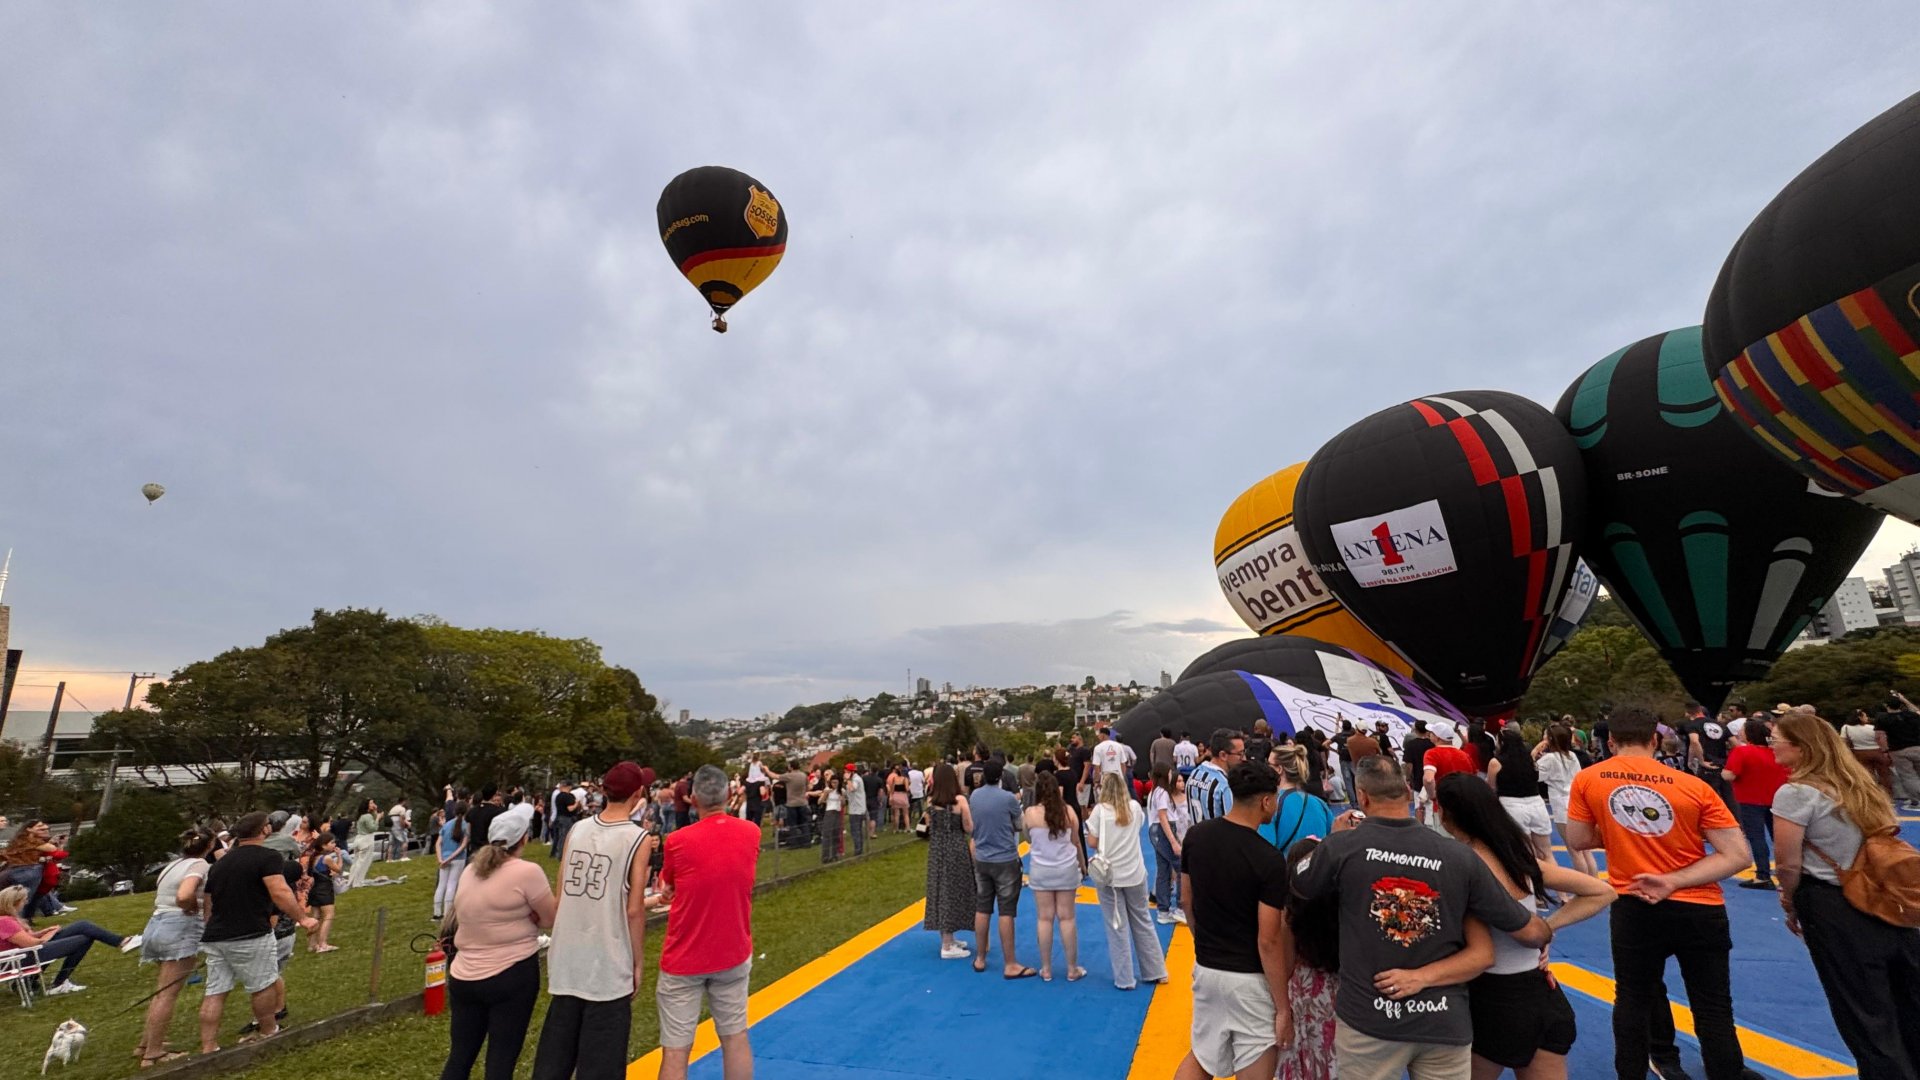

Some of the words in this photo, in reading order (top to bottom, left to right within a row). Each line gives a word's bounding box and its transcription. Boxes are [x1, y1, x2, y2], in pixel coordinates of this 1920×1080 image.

[1616, 466, 1669, 480] BR-SONE
[1342, 526, 1446, 560] ANTENA
[1381, 568, 1399, 576] 98.1
[1400, 564, 1415, 573] FM
[1422, 565, 1454, 577] GAÚCHA
[1600, 771, 1674, 784] ORGANIZAÇÃO
[1365, 848, 1442, 872] TRAMONTINI
[564, 850, 612, 900] 33
[1373, 997, 1402, 1019] Off
[1405, 996, 1448, 1013] Road
